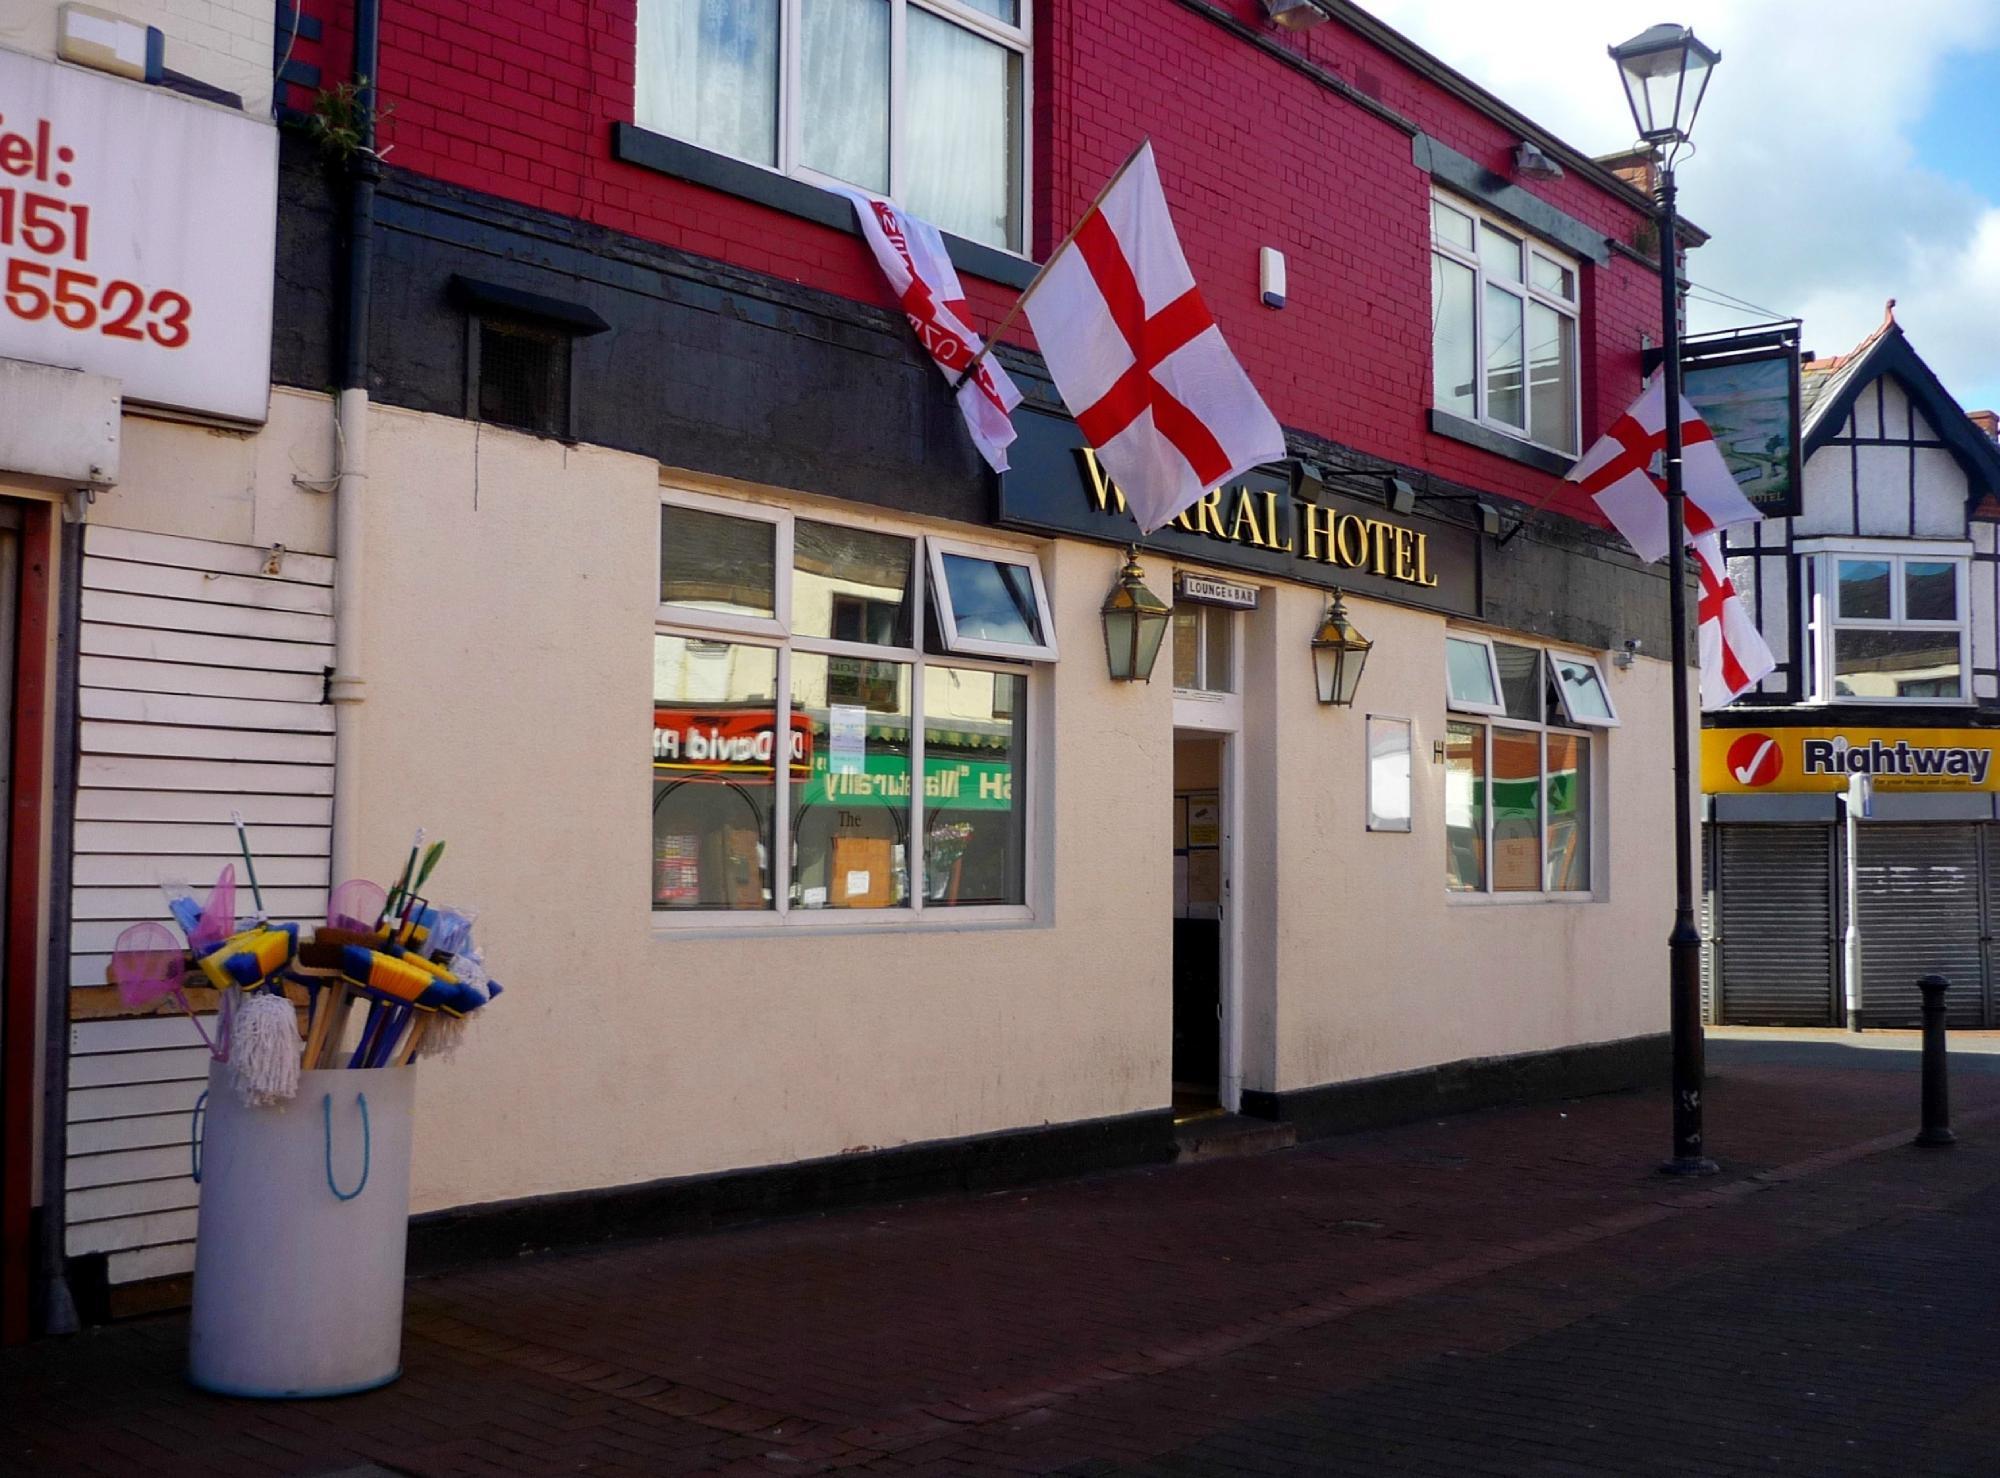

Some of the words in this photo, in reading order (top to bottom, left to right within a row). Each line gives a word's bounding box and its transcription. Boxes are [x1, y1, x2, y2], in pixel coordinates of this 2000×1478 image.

[0, 113, 75, 187] el:
[4, 257, 191, 348] 5523
[1083, 448, 1292, 551] WRAL
[1305, 503, 1437, 587] HOTEL
[1190, 582, 1226, 597] LOUNGE
[1234, 589, 1253, 602] BAR
[1804, 736, 1991, 782] Rightway
[838, 811, 861, 828] The
